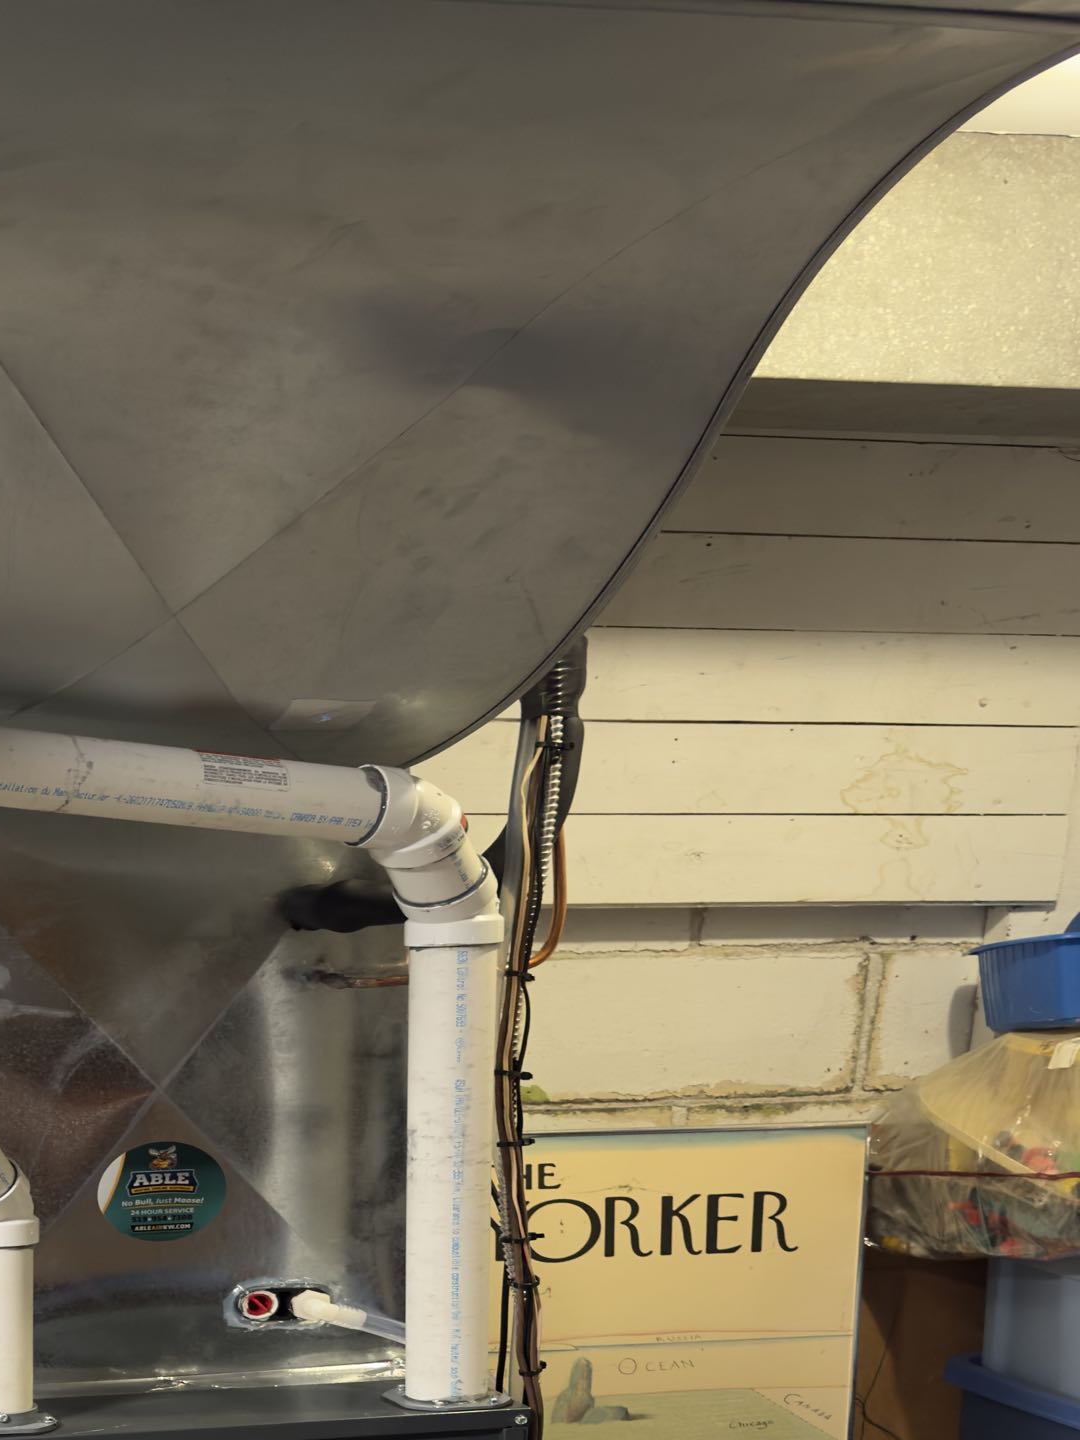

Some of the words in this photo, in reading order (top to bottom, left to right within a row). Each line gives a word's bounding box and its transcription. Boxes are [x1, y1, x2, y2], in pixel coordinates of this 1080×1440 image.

[133, 1172, 190, 1186] ABLE
[495, 1190, 799, 1263] ORKER
[617, 1357, 695, 1375] OCEAN
